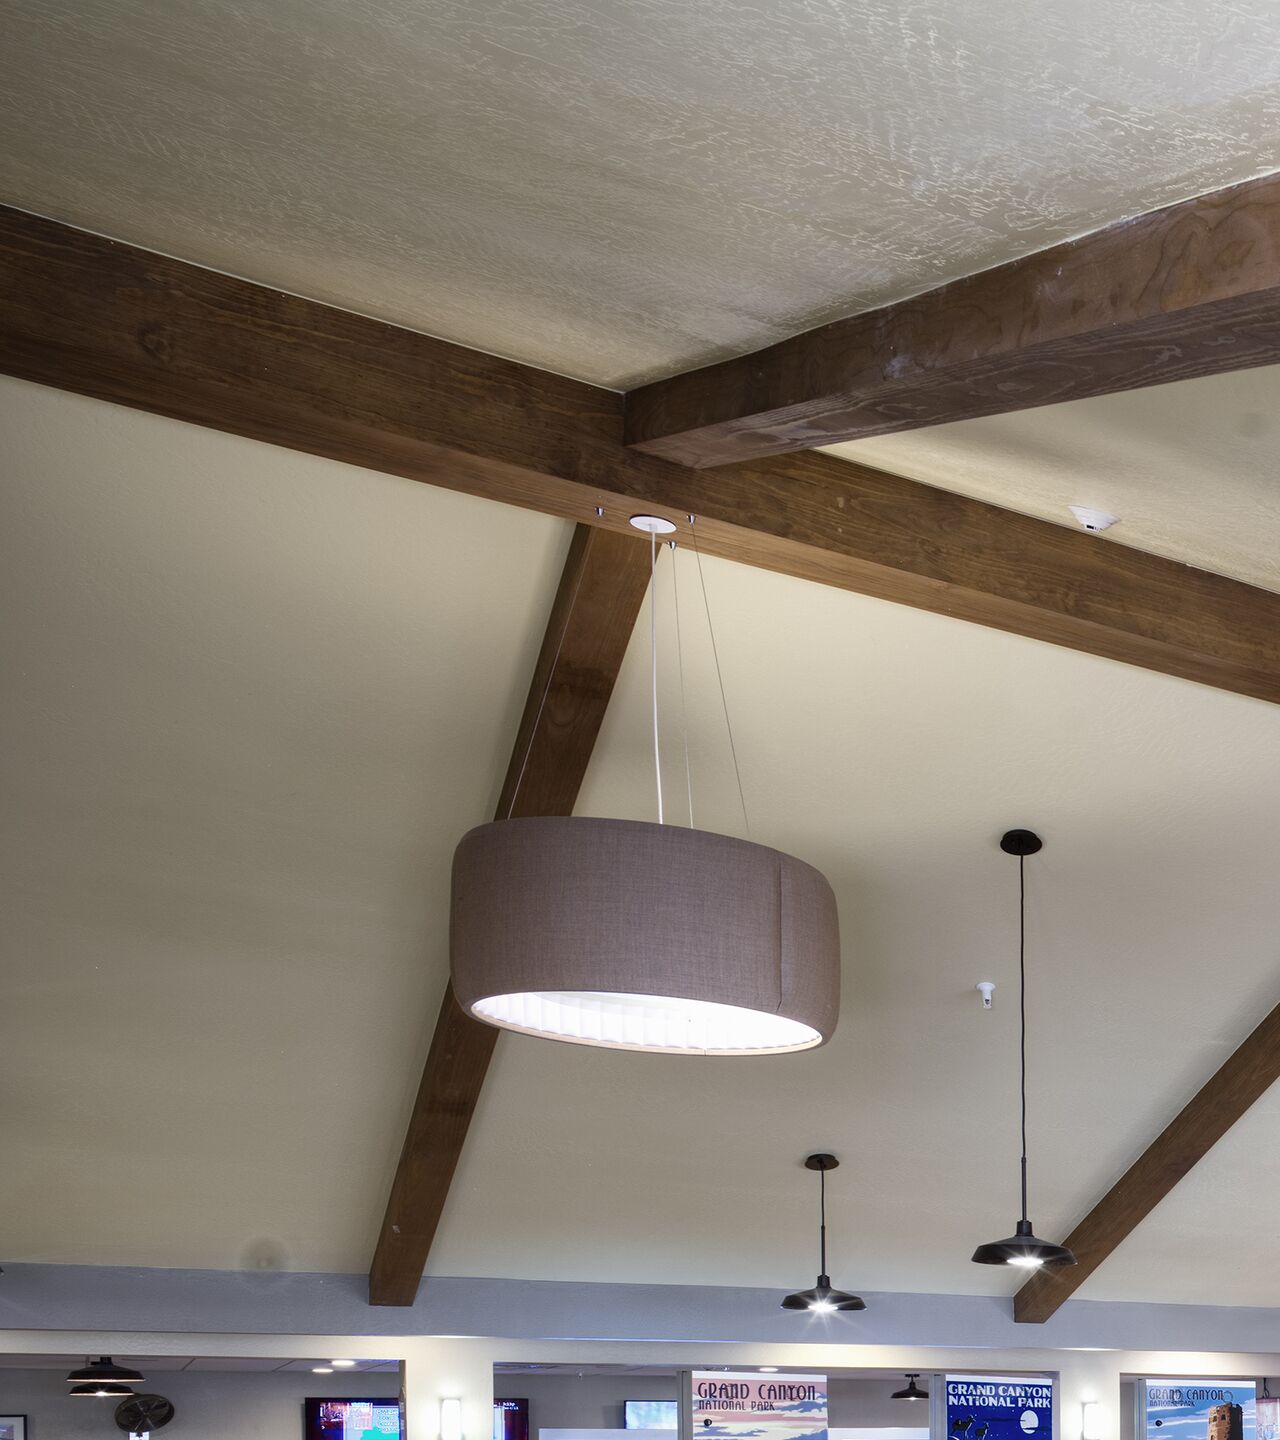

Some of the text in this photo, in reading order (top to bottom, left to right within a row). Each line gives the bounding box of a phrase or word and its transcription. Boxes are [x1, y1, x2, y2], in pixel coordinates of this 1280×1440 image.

[698, 1382, 816, 1401] GRAND CANYON
[948, 1384, 1052, 1398] GRAND CANYON
[1149, 1388, 1224, 1401] GRAND CANYON
[698, 1399, 776, 1411] NATIONAL PARK
[948, 1395, 1051, 1408] NATIONAL PARK
